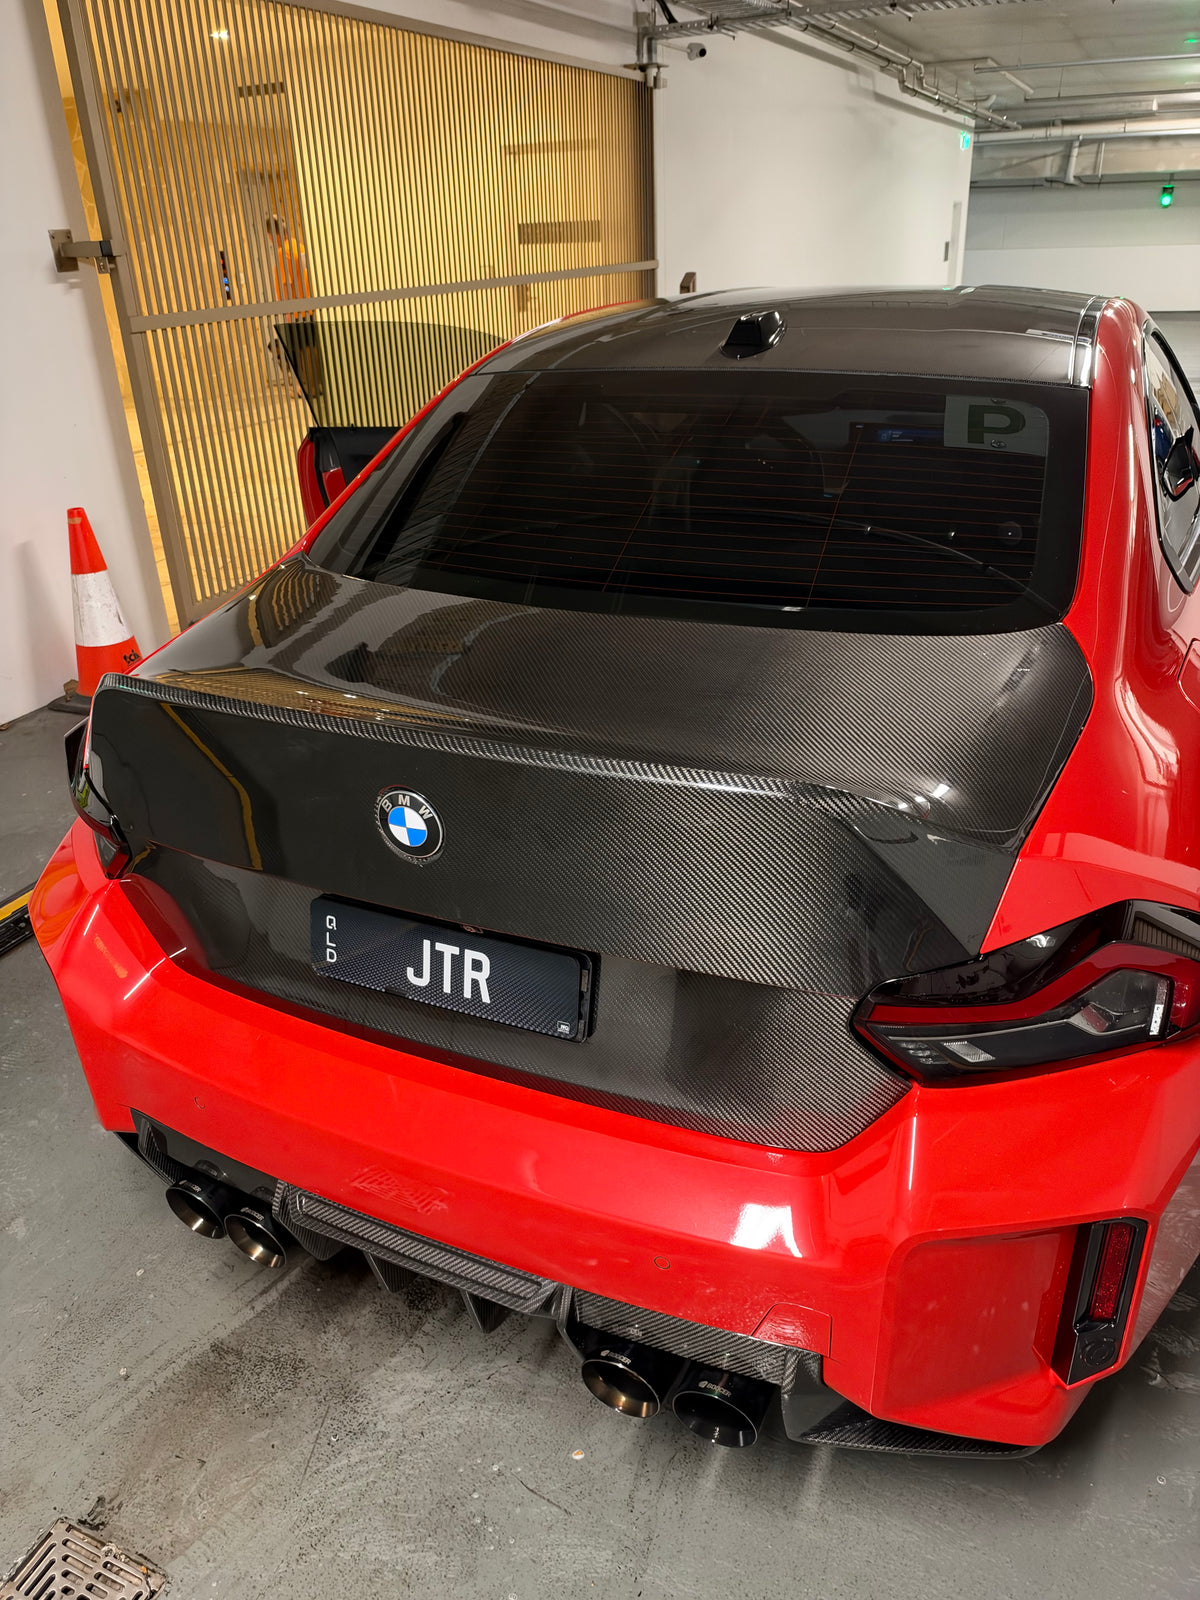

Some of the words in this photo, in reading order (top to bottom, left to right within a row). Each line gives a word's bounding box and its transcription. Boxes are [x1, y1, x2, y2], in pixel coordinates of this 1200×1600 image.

[968, 404, 1026, 444] P
[381, 794, 434, 821] BMW
[326, 915, 337, 963] QLD
[406, 939, 491, 1004] JTR
